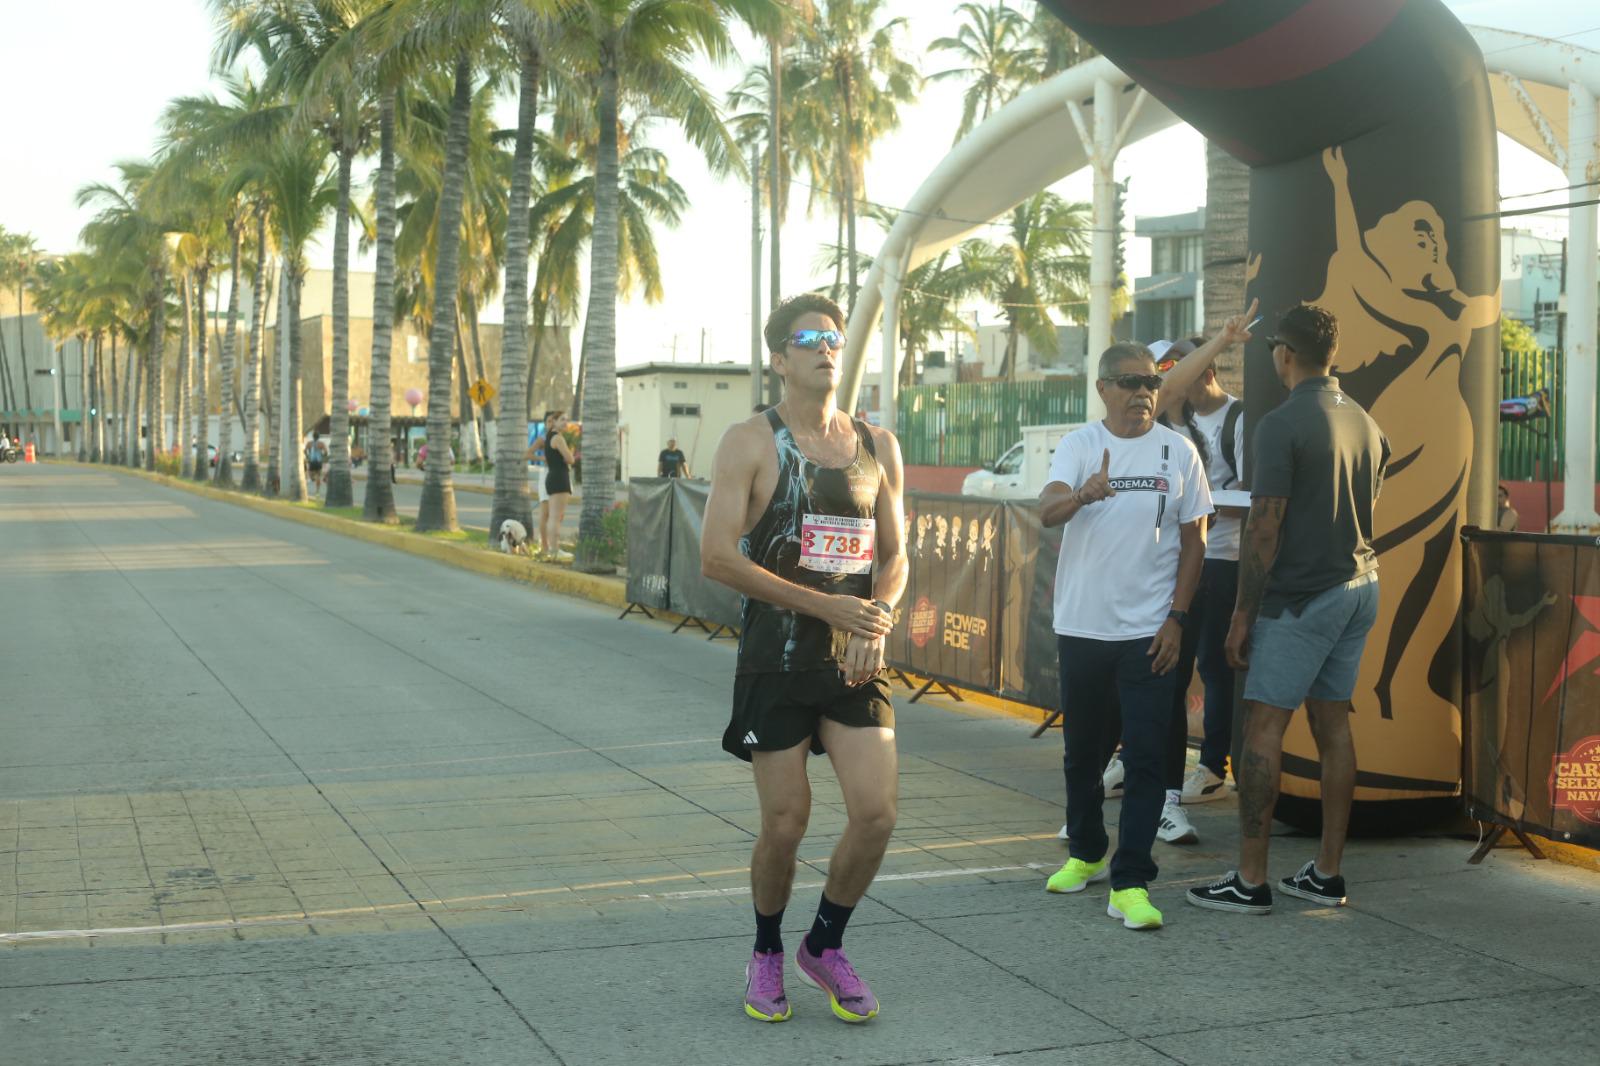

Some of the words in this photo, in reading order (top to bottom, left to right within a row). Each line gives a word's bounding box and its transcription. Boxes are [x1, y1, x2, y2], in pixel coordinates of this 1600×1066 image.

[1108, 479, 1156, 489] ODEMAZ
[823, 535, 861, 554] 738
[944, 611, 988, 636] POWER
[943, 628, 970, 650] ADE
[1556, 762, 1600, 777] CAR
[1555, 778, 1600, 790] SELE
[1567, 791, 1600, 801] NAY
